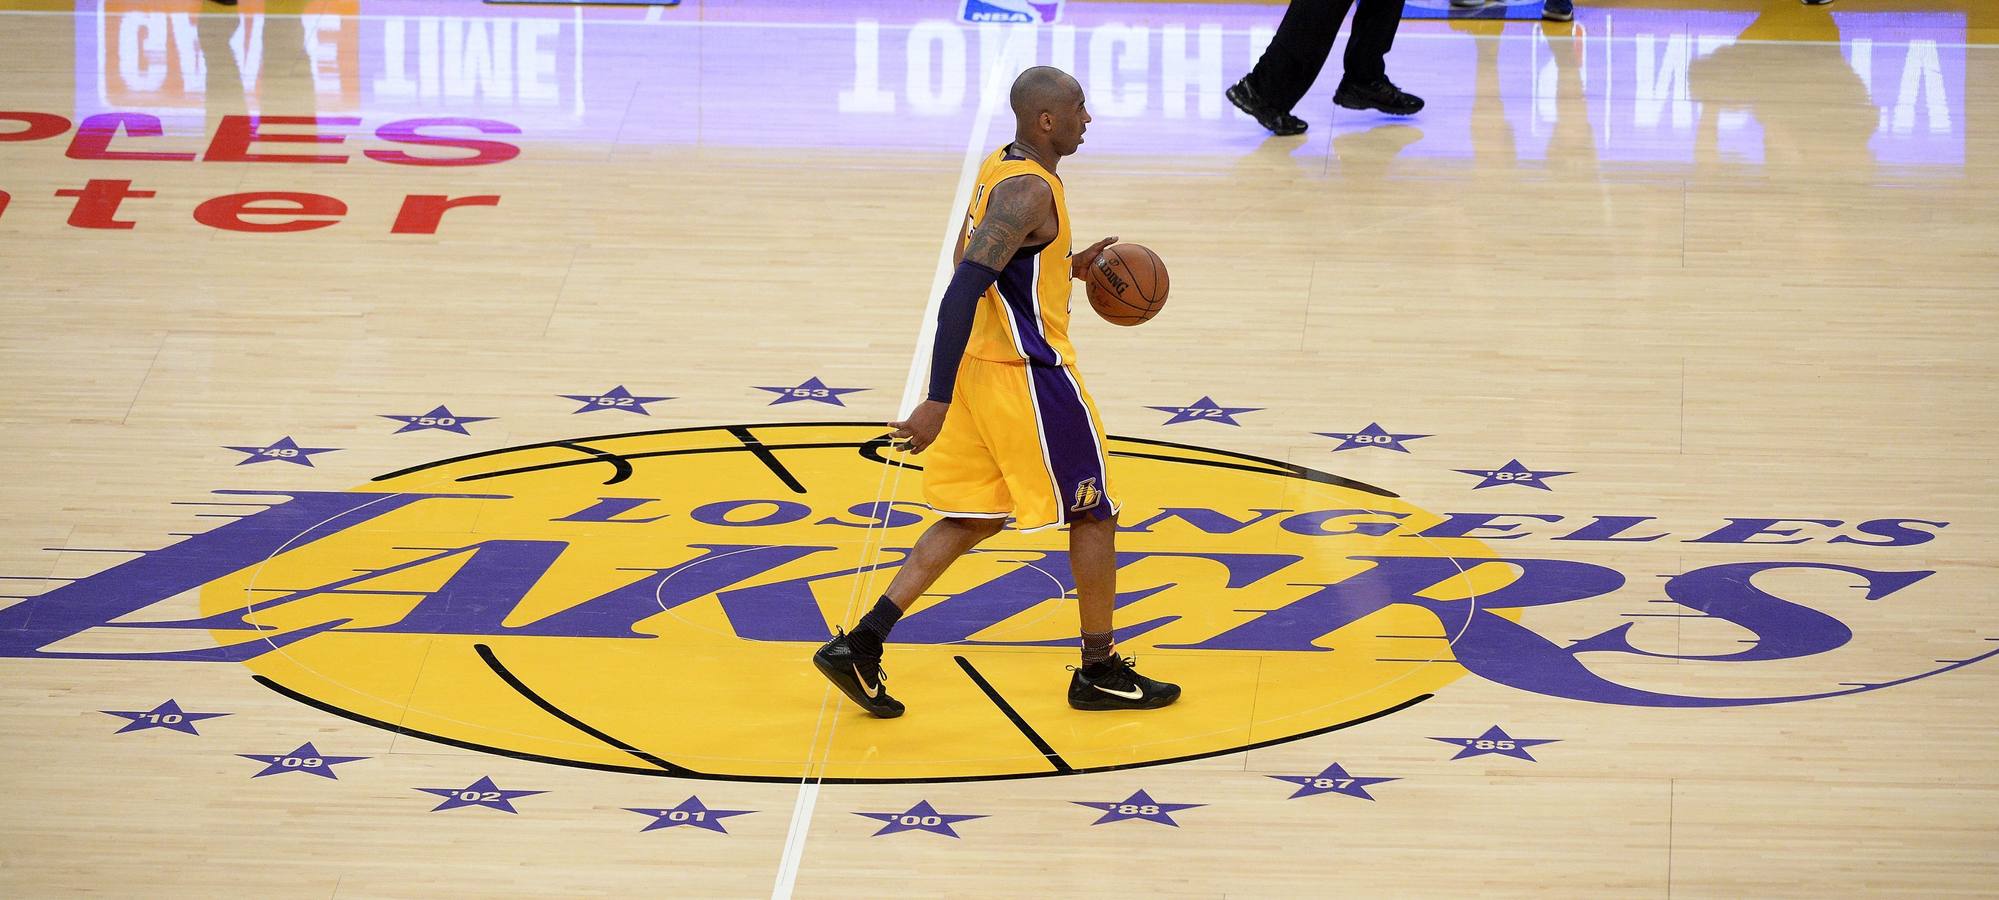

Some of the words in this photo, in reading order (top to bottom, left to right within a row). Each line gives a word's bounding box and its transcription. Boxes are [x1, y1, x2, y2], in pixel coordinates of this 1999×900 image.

[972, 12, 1028, 22] NBA
[0, 178, 501, 234] ter
[784, 388, 829, 397] '53
[590, 397, 634, 407] '52
[1177, 408, 1223, 417] '72
[411, 417, 455, 426] '50
[1347, 434, 1392, 444] '80
[259, 447, 298, 457] '49
[1487, 471, 1533, 481] '82
[549, 497, 928, 528] LOS
[1003, 508, 1950, 547] NGELES
[139, 713, 183, 724] '10
[1467, 738, 1516, 750] '85
[273, 756, 323, 768] '09
[1305, 777, 1356, 789] '87
[451, 790, 502, 803] '02
[1109, 804, 1159, 816] '88
[660, 810, 706, 822] '01
[891, 815, 942, 827] '00
